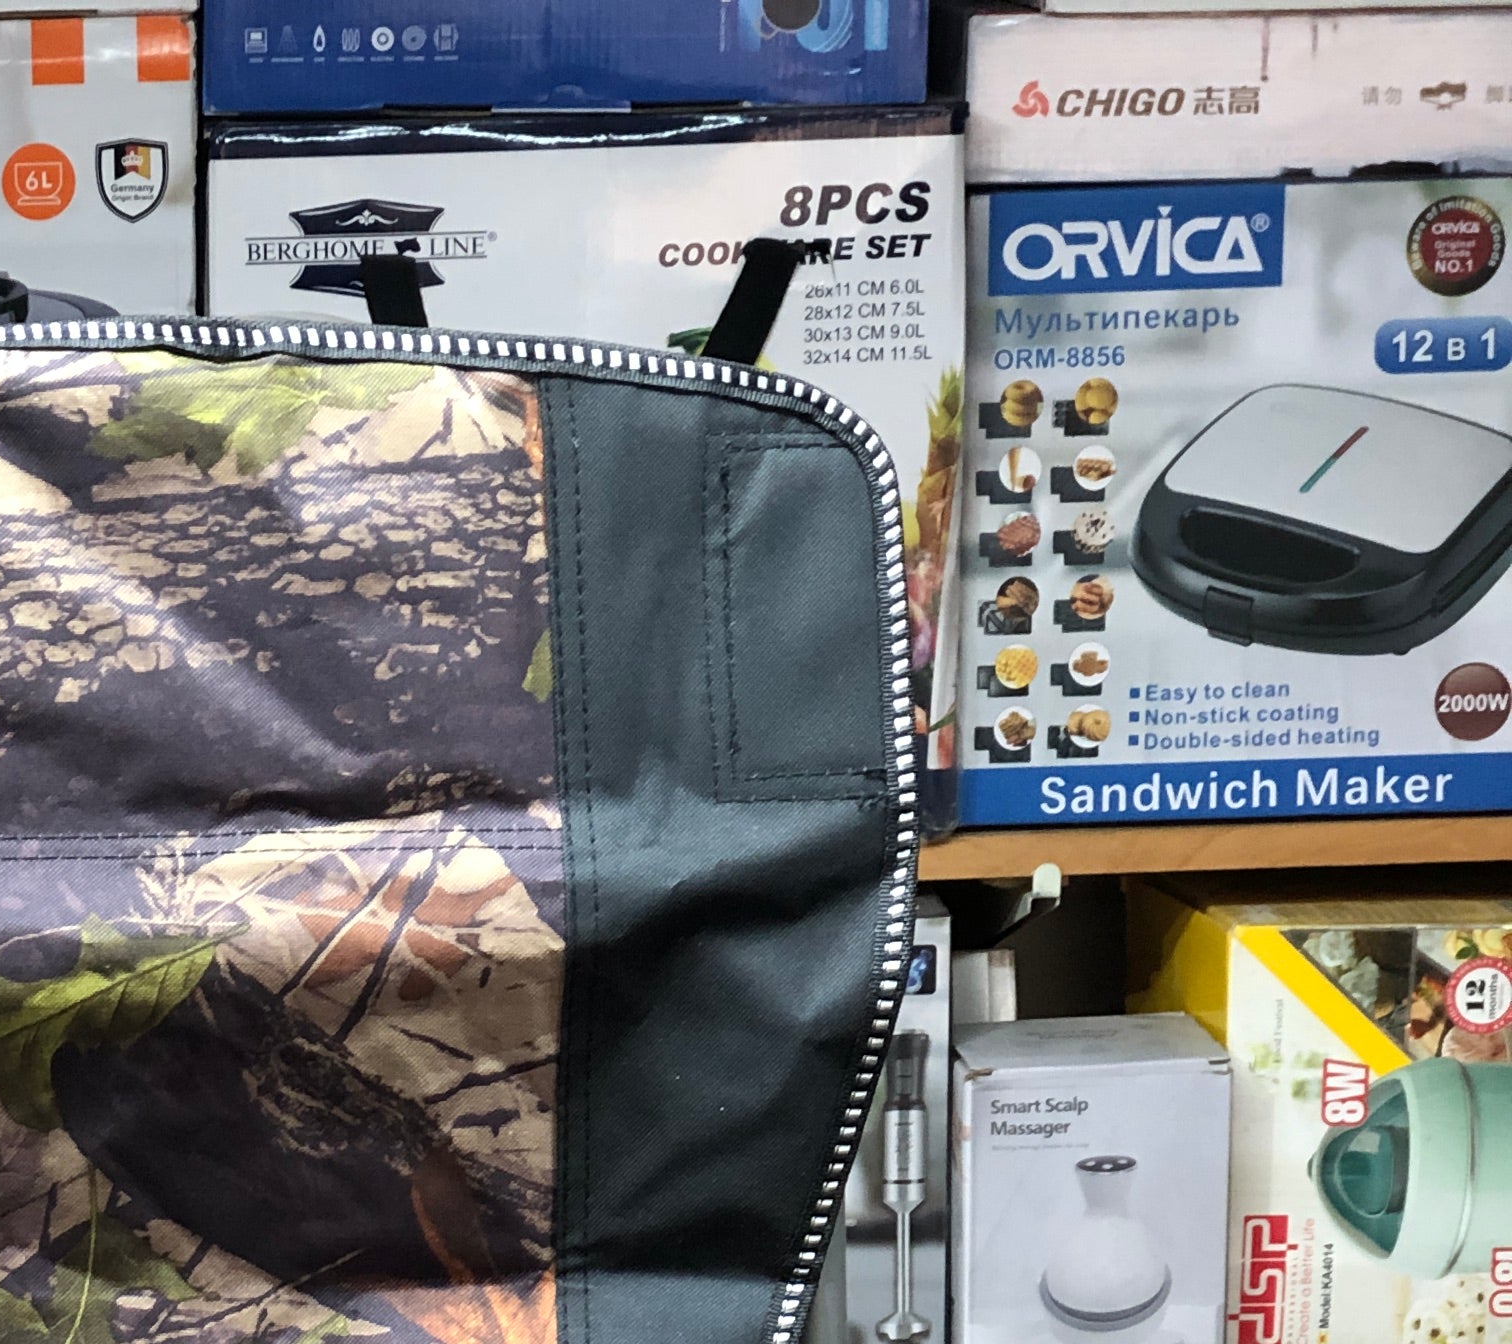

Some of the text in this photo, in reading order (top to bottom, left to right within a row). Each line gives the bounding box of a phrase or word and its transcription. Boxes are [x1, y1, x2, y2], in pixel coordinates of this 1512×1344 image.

[1056, 87, 1186, 118] CHIGO
[1193, 84, 1261, 116] 志高
[25, 170, 53, 191] 6L
[110, 183, 155, 194] Germany
[780, 181, 931, 228] 8PCS
[430, 236, 485, 257] LINE
[865, 234, 932, 259] SET
[1434, 259, 1473, 273] NO.1
[805, 279, 924, 299] 26x11 CM 6.0L
[804, 302, 925, 321] 28x12 CM 7.5L
[995, 305, 1240, 339] Мультипекарь
[804, 323, 925, 343] 30x13 CM 9.0L
[803, 345, 932, 365] 32x14 CM 11.5L
[1392, 329, 1434, 363] 12
[1480, 327, 1496, 360] 1
[994, 345, 1126, 370] ORM-8856
[1145, 681, 1290, 704] Easy to clean
[1437, 692, 1510, 714] 2000W
[1144, 704, 1339, 726] Non-stick coating
[1144, 726, 1380, 750] Double-sided heating
[1040, 766, 1454, 815] Sandwich Maker
[1465, 980, 1486, 1011] 12
[1322, 1059, 1369, 1126] 8W
[990, 1096, 1089, 1116] Smart Scalp
[990, 1121, 1071, 1139] Massager
[1303, 1218, 1315, 1241] Life
[1300, 1243, 1314, 1285] Better
[1302, 1287, 1312, 1298] a
